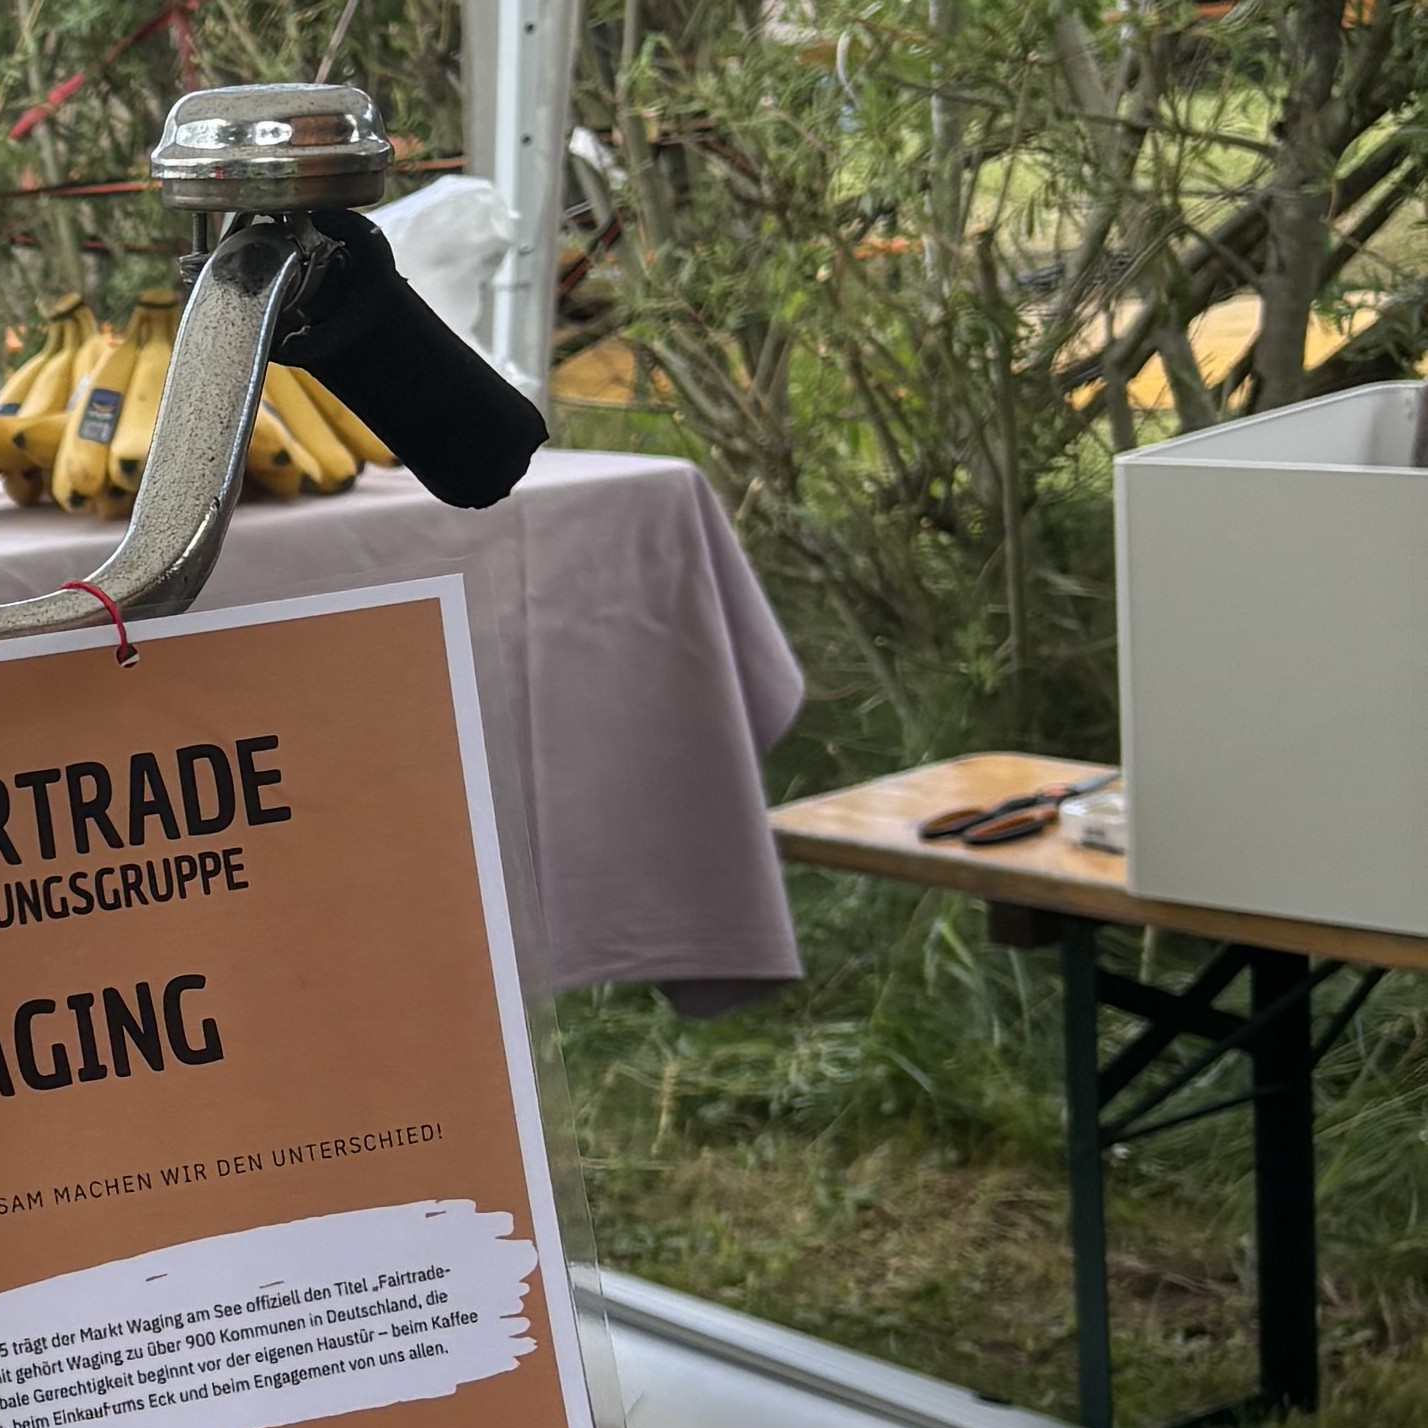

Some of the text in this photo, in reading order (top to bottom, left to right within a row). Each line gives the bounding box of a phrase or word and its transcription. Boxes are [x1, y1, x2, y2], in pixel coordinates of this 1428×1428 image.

[54, 1173, 152, 1205] MACHEN
[160, 1163, 208, 1187] WIR
[217, 1153, 263, 1177] DEN
[272, 1123, 443, 1168] UNTERSCHIED!
[12, 1336, 48, 1355] trägt
[52, 1332, 75, 1348] der
[80, 1323, 122, 1342] Markt
[126, 1313, 185, 1334] Waging
[187, 1309, 210, 1324] am
[214, 1304, 243, 1319] See
[246, 1290, 301, 1313] offiziell
[304, 1287, 332, 1303] den
[334, 1278, 368, 1298] Titel
[372, 1264, 451, 1292] „Fairtrade-
[16, 1360, 64, 1384] gehört
[66, 1350, 124, 1373] Waging
[126, 1347, 144, 1361] zu
[147, 1340, 182, 1357] über
[185, 1331, 216, 1349] 900
[220, 1317, 306, 1343] Kommunen
[309, 1313, 323, 1327] in
[326, 1295, 423, 1324] Deutschland,
[426, 1290, 449, 1306] die
[33, 1372, 135, 1405] Gerechtigkeit
[137, 1362, 195, 1385] beginnt
[198, 1358, 222, 1373] vor
[226, 1352, 251, 1368] der
[255, 1342, 314, 1364] eigenen
[317, 1328, 375, 1352] Haustür
[391, 1320, 428, 1338] beim
[431, 1310, 479, 1330] Kaffee
[148, 1391, 177, 1408] Eck
[179, 1384, 209, 1403] und
[212, 1378, 250, 1396] beim
[254, 1360, 346, 1388] Engagement
[348, 1357, 376, 1372] von
[379, 1350, 406, 1365] uns
[409, 1342, 449, 1360] allen.
